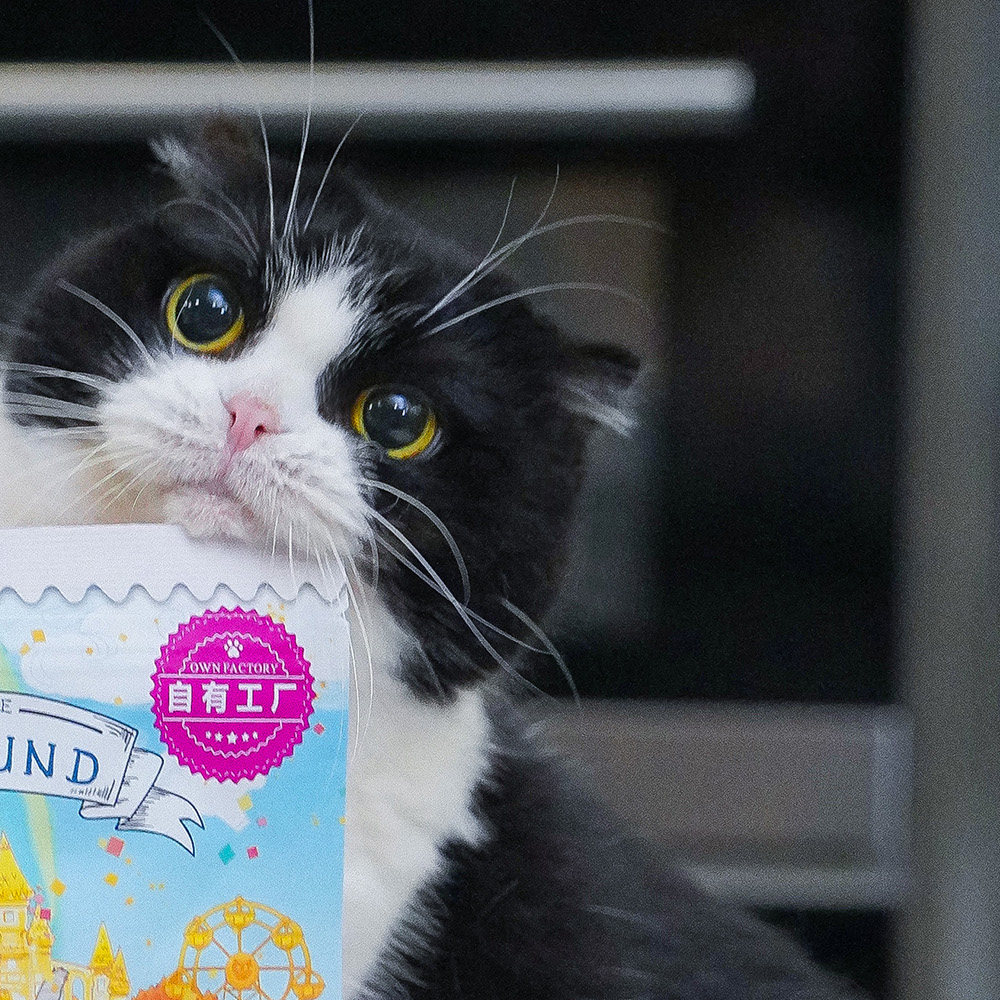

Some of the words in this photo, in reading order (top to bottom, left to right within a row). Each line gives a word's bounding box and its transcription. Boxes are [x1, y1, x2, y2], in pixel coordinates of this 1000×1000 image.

[190, 662, 221, 674] OWN
[223, 662, 279, 674] FACTORY
[168, 680, 298, 714] 自有工厂
